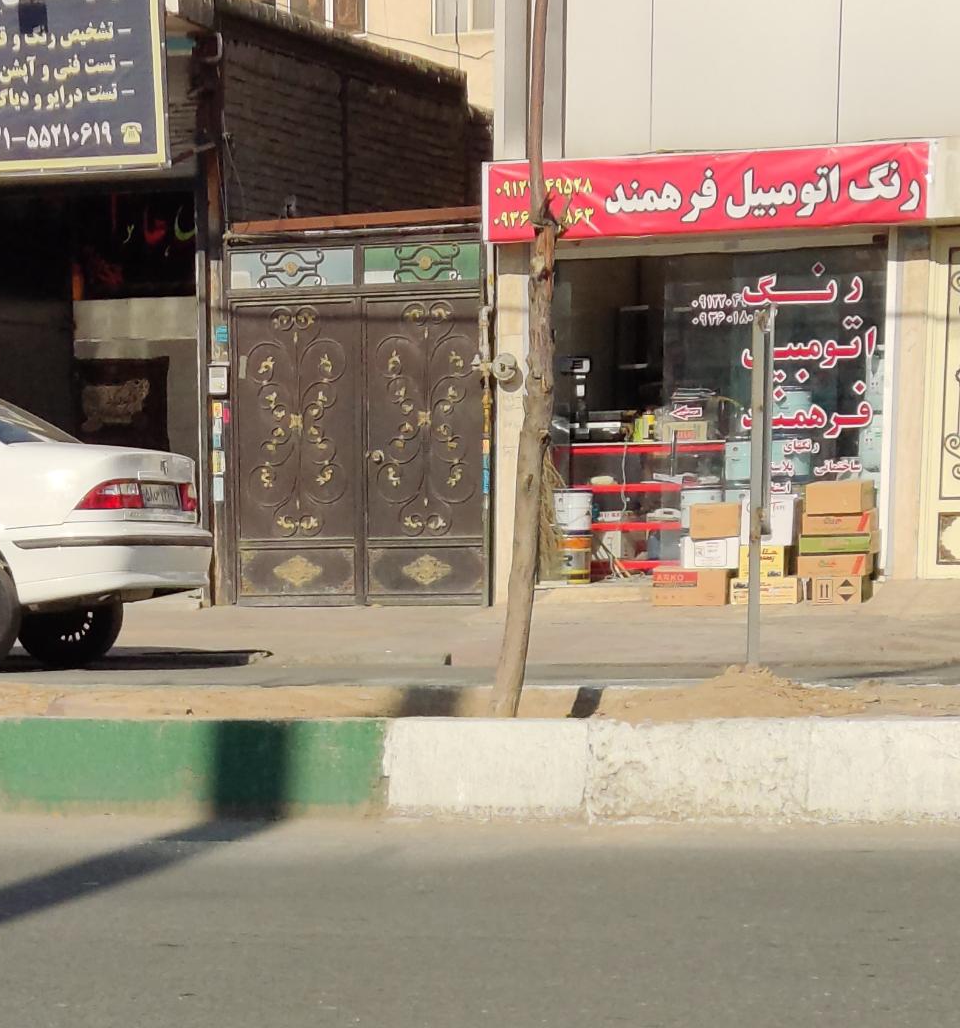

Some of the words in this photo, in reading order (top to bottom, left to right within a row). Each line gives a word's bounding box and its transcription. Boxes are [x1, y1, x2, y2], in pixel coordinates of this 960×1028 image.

[12, 33, 21, 51] و
[24, 25, 56, 49] رنگ
[60, 22, 114, 49] تشخیص
[0, 56, 36, 84] آپشن
[41, 65, 50, 82] و
[54, 54, 81, 80] فنی
[84, 54, 116, 74] تست
[33, 97, 42, 110] و
[45, 85, 83, 110] درایو
[86, 83, 118, 103] تست
[496, 177, 593, 197] ۰۹۱۲۴۹۵۲۸
[604, 167, 718, 222] فرهمند
[725, 163, 840, 218] اتومبیل
[849, 160, 920, 211] رنگ
[494, 208, 594, 227] ۰۹۳۶۸۶۳
[741, 262, 864, 306] رنگ
[741, 315, 877, 383] اتومبی
